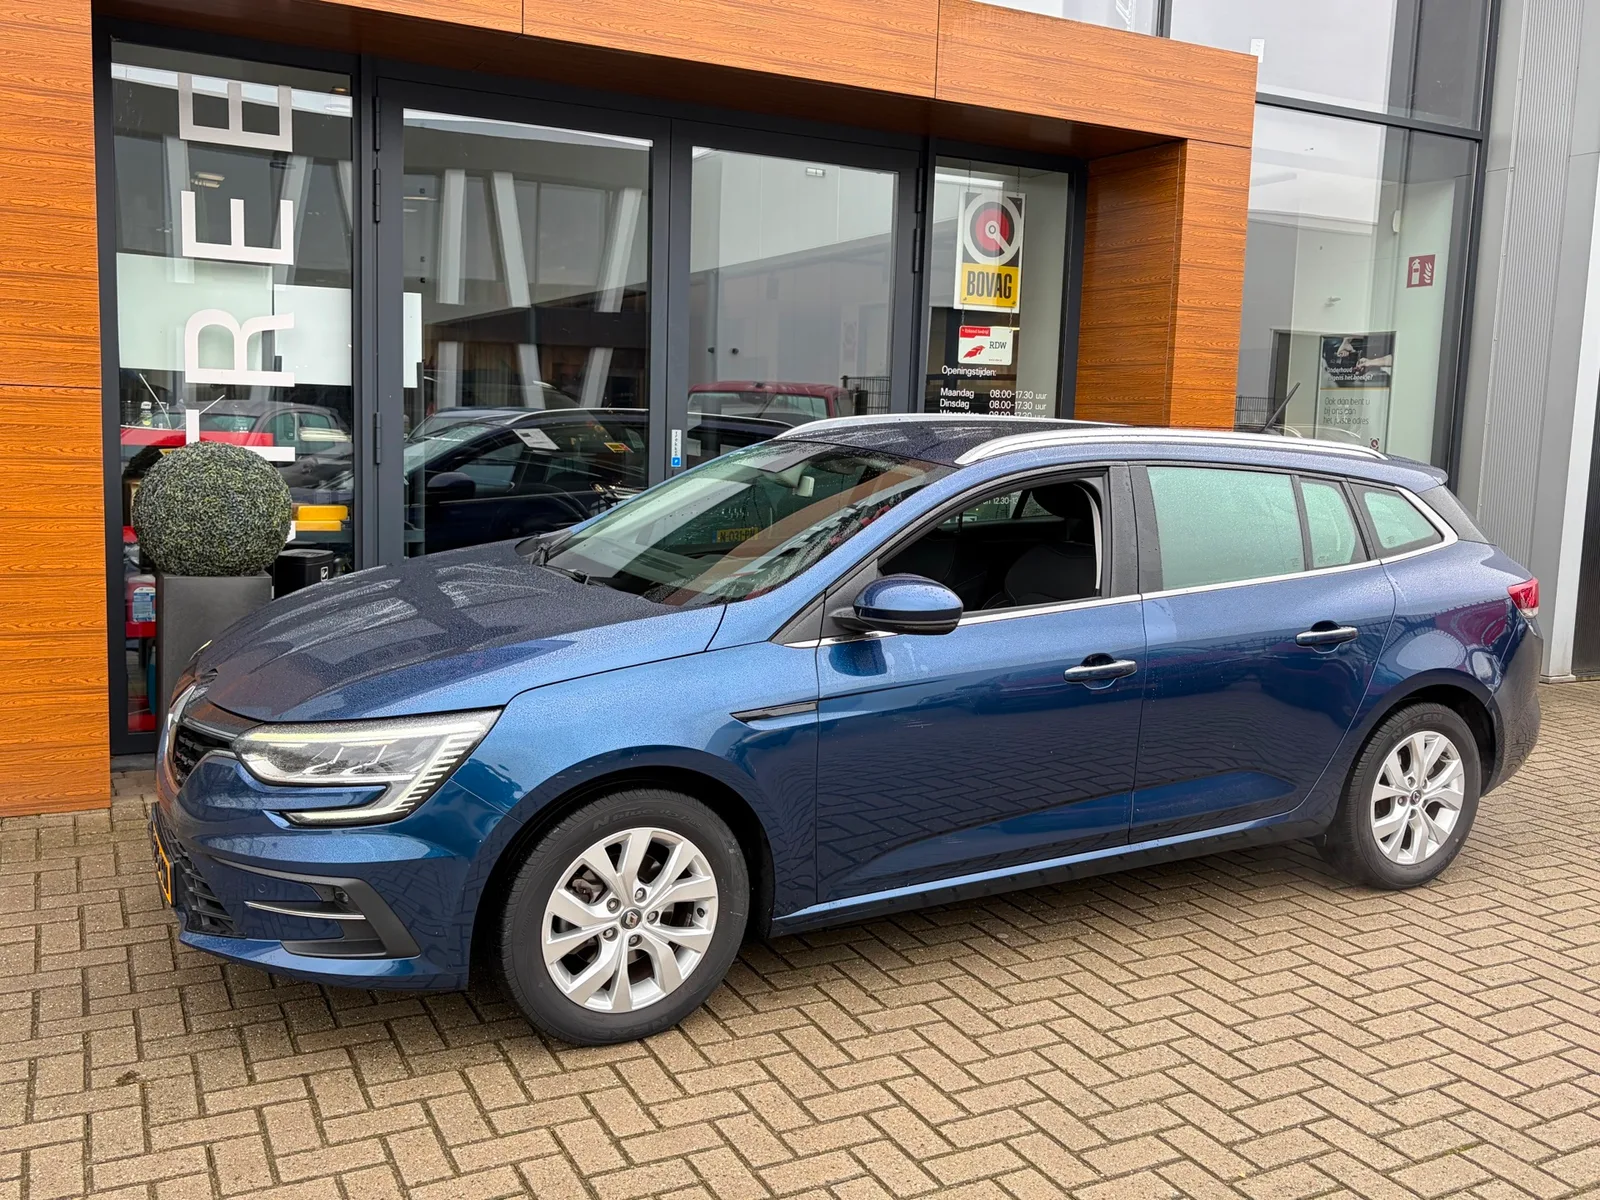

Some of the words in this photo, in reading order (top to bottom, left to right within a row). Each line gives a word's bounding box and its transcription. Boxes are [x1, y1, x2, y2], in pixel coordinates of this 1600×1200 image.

[967, 270, 1012, 299] BOVAG
[989, 341, 1007, 350] RDW
[941, 365, 997, 377] Openingstijden:
[940, 387, 975, 399] Maandag
[1035, 392, 1048, 400] uur
[940, 398, 970, 409] Dinsdag
[988, 400, 1033, 410] 08.00-17.30
[1324, 397, 1336, 406] Ook
[993, 496, 1019, 505] 12.30-13
